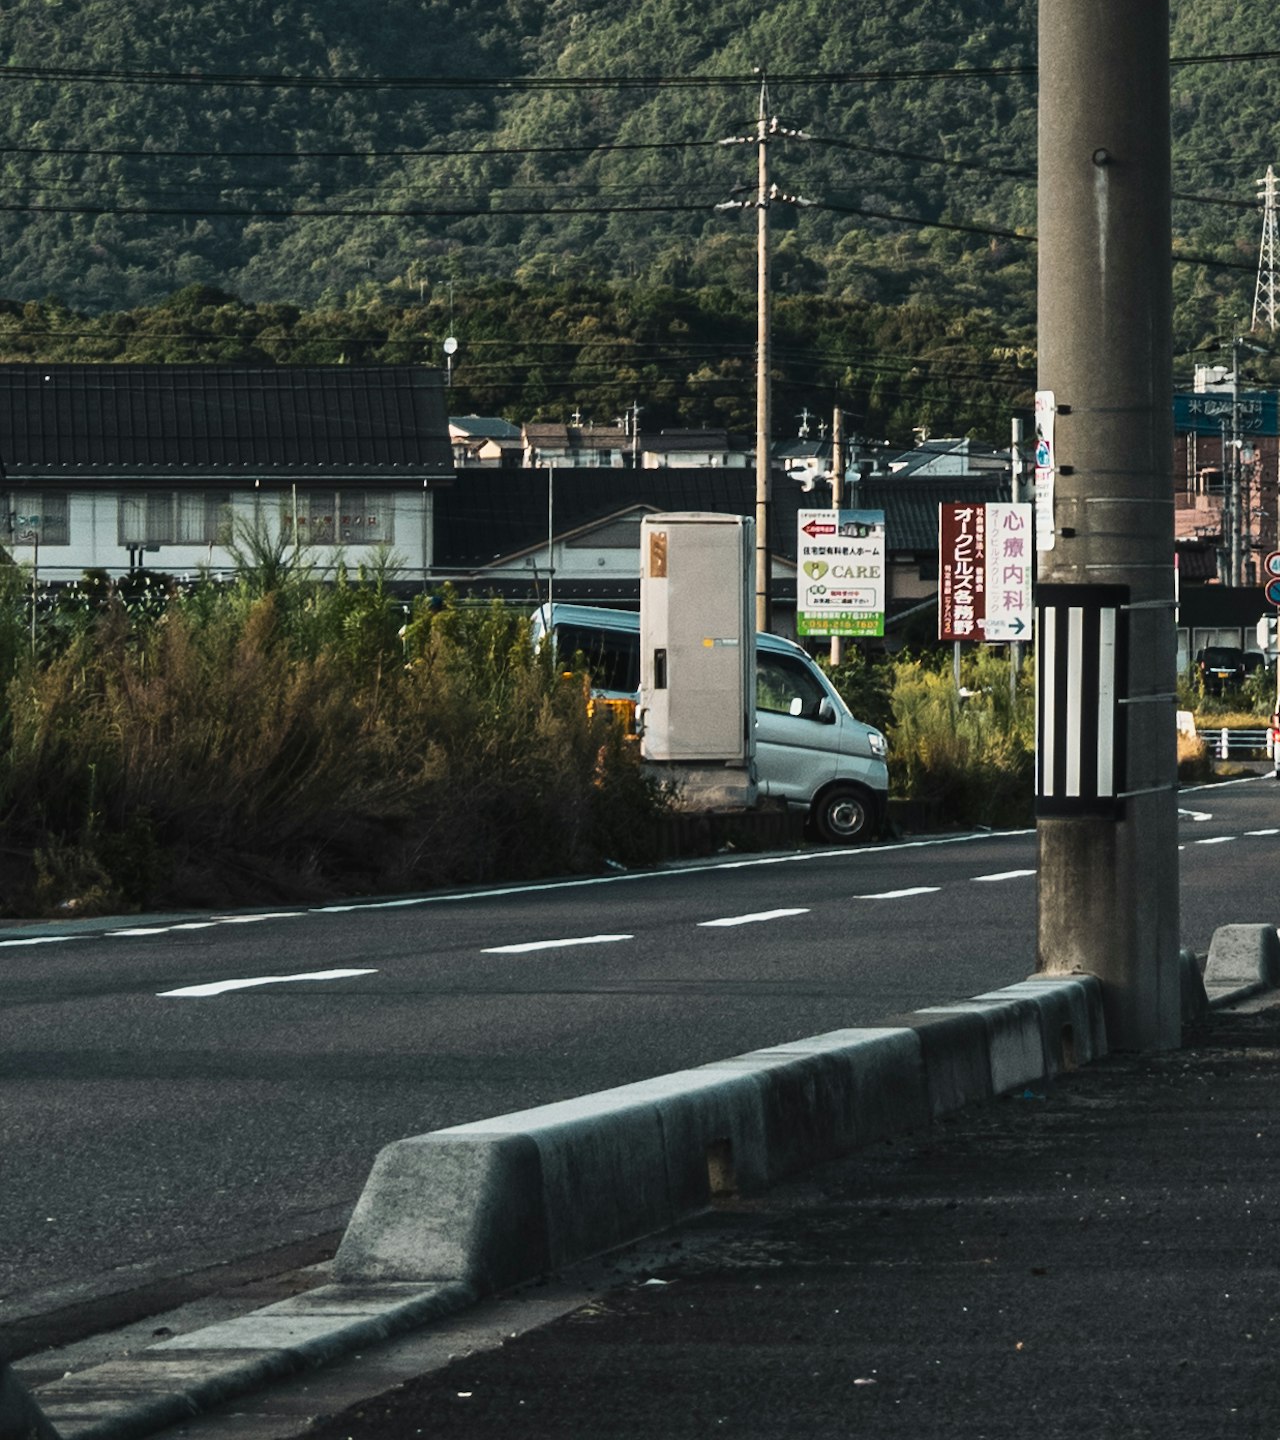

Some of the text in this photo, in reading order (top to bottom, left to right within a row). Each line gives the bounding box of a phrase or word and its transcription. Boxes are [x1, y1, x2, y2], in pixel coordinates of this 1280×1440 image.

[803, 546, 880, 555] 住宅型有料老人ホーム
[831, 565, 881, 578] CARE
[953, 507, 974, 635] オークヒルズ各務野
[1003, 510, 1024, 611] 心療内科
